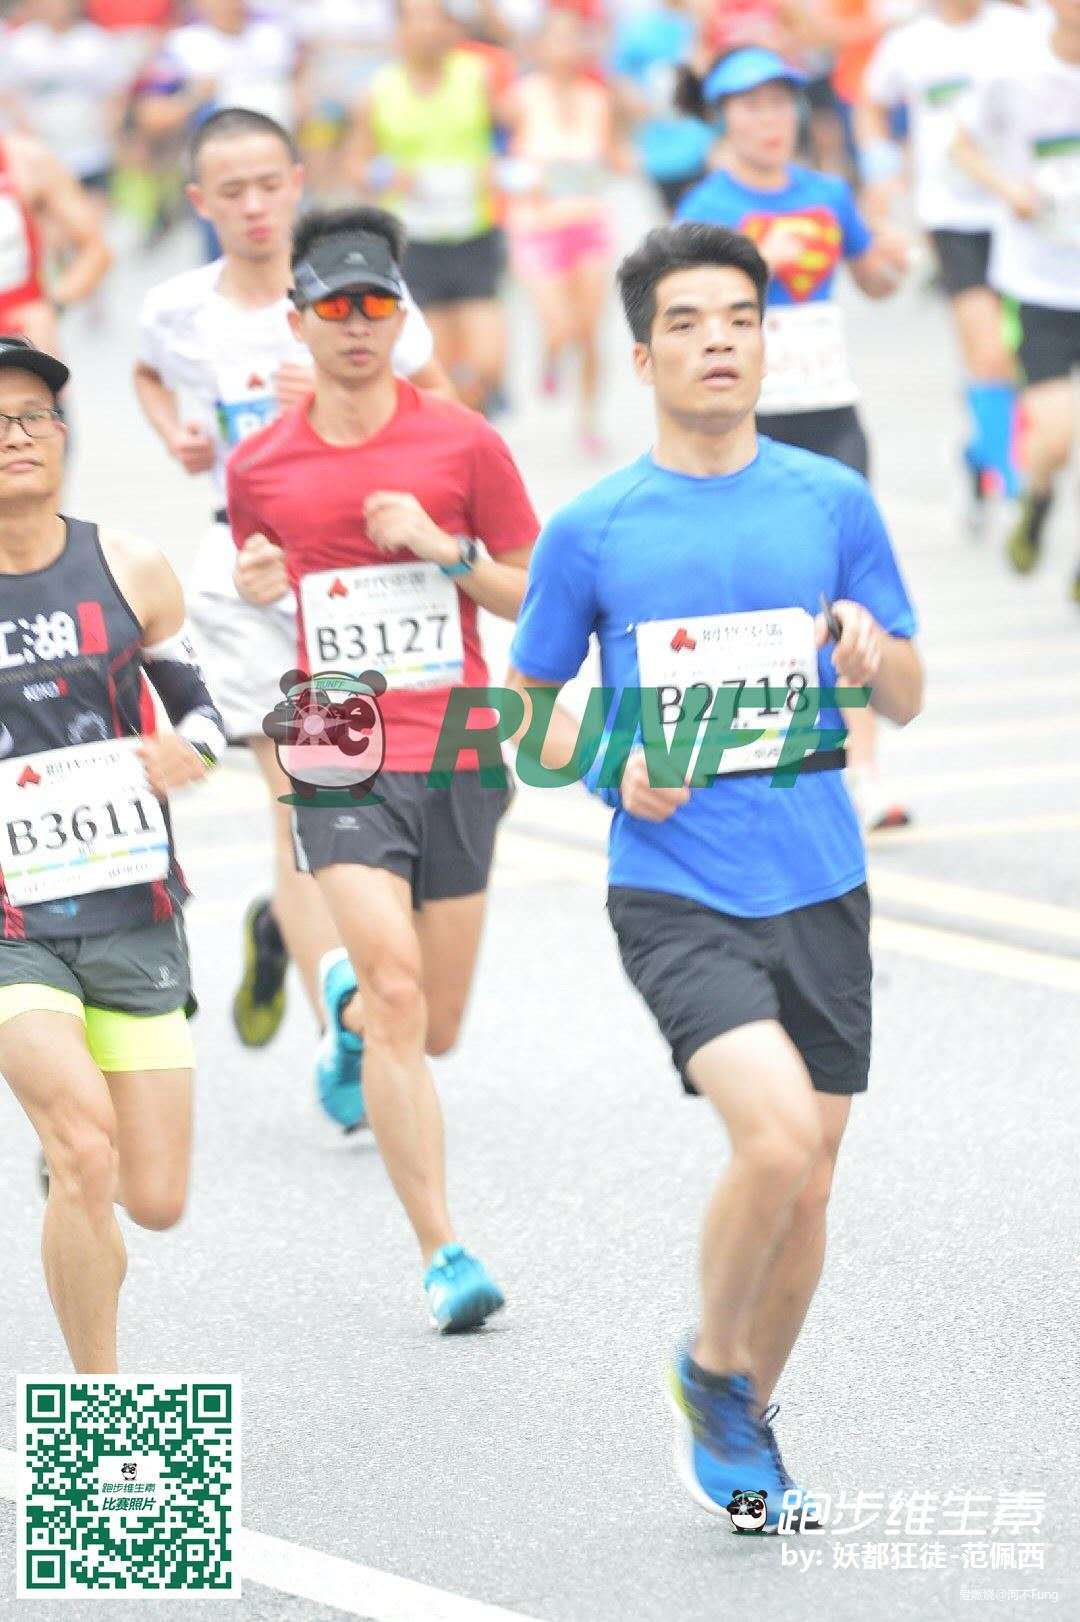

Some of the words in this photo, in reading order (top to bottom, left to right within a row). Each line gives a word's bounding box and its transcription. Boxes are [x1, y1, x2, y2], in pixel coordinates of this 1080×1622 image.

[316, 614, 449, 663] B3127
[656, 672, 810, 725] B2718
[6, 798, 156, 857] B3611
